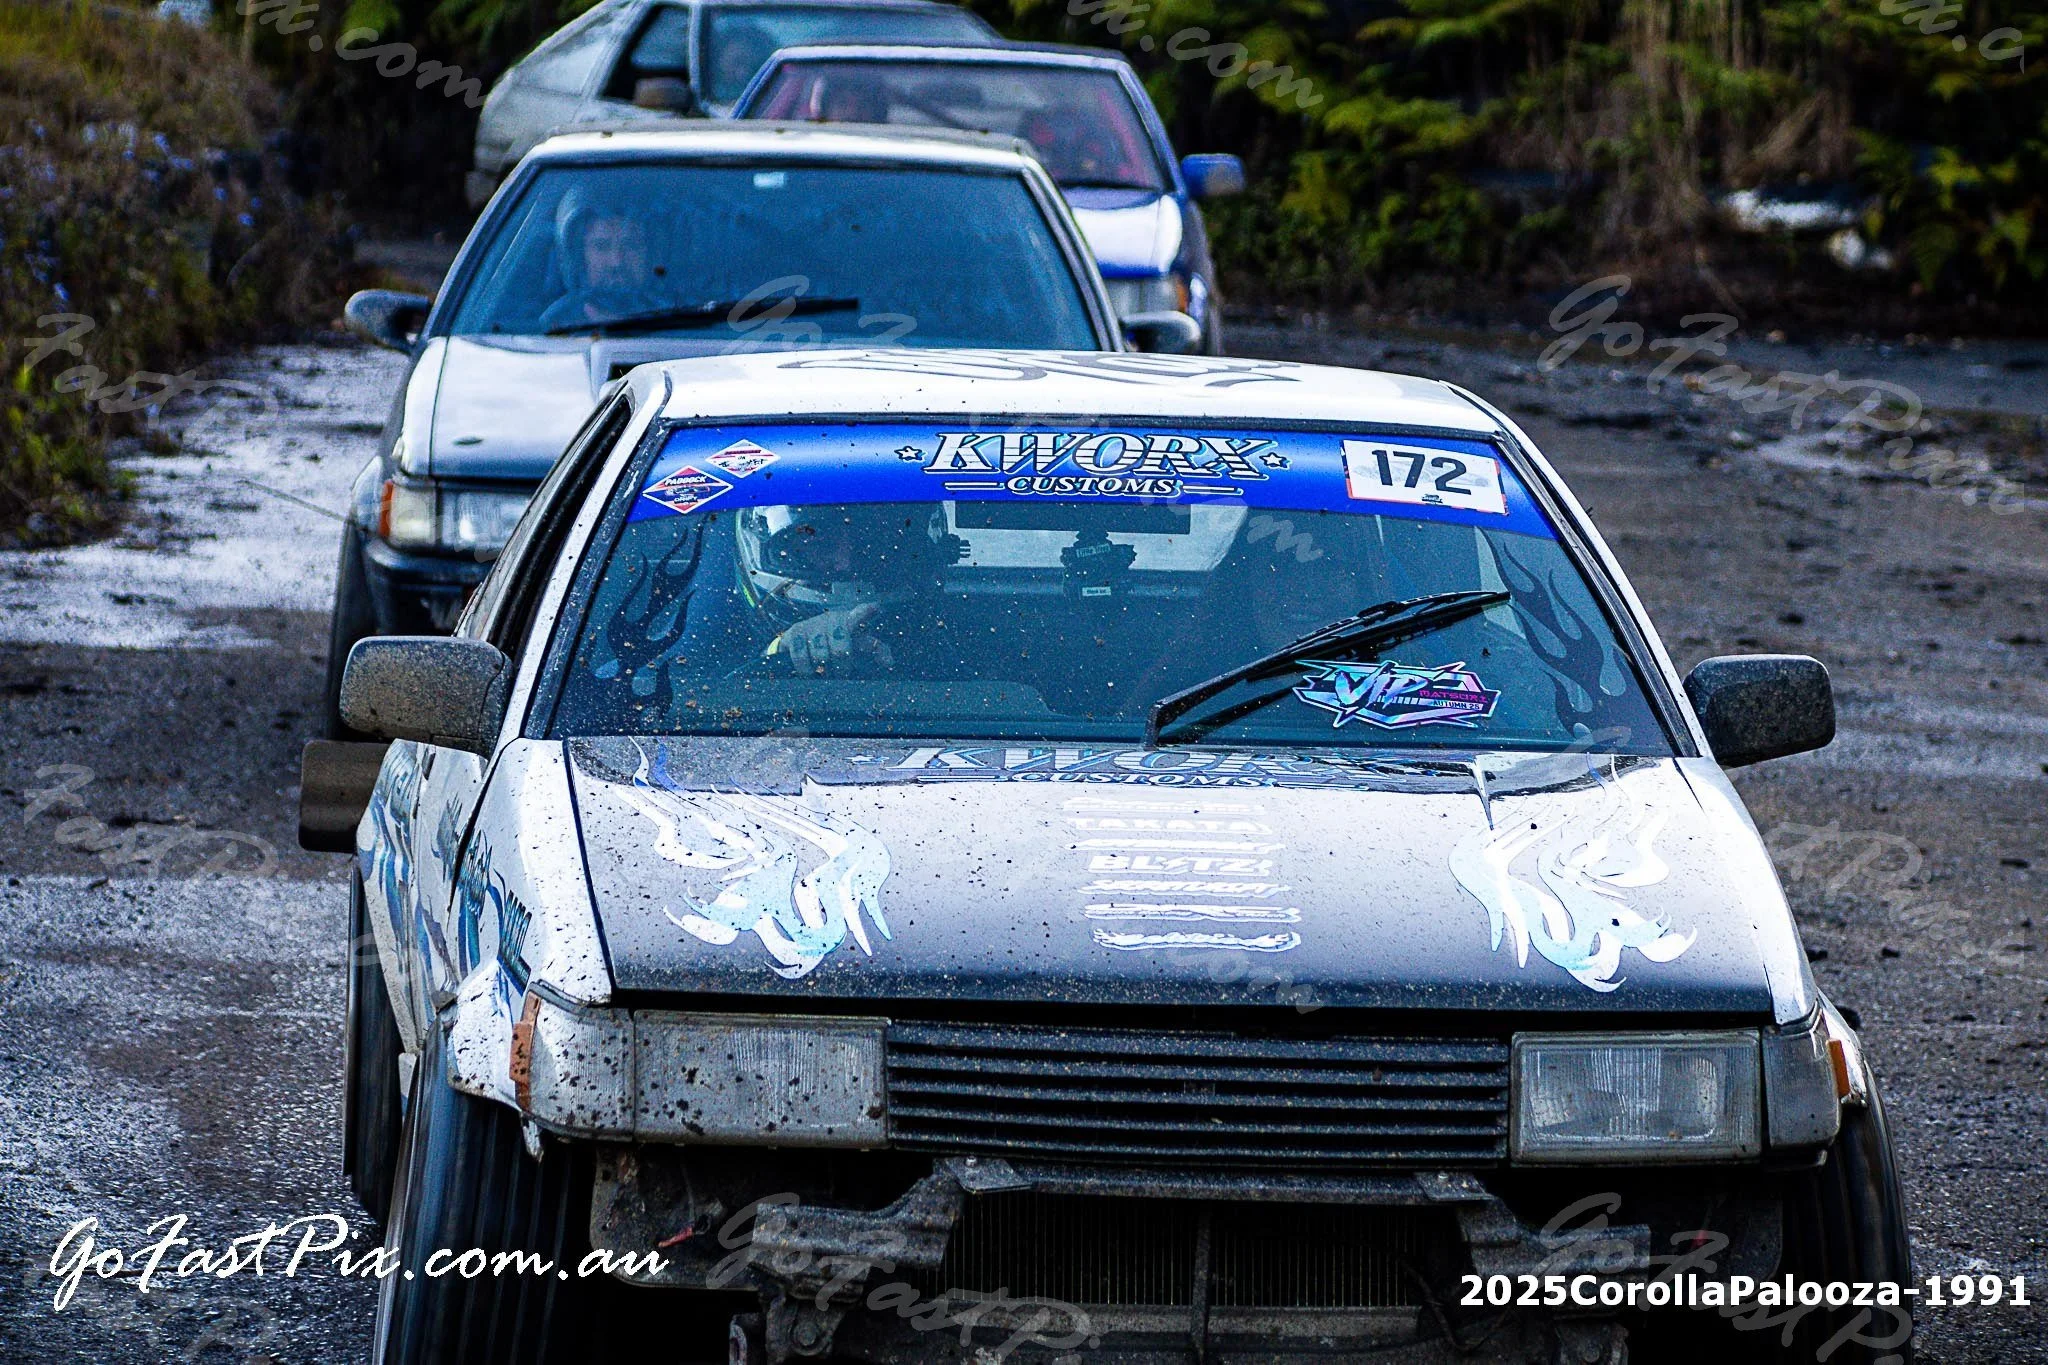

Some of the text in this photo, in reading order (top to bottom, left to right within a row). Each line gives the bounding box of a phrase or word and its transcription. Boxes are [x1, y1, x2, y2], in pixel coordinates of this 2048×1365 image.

[923, 432, 1278, 480] KWORX
[664, 475, 708, 487] PADDOCK
[1371, 449, 1472, 495] 172
[1004, 476, 1183, 497] CUSTOMS
[1333, 661, 1429, 711] VIP
[1432, 700, 1467, 709] AUTUMN
[1012, 772, 1266, 787] CUSTOMS
